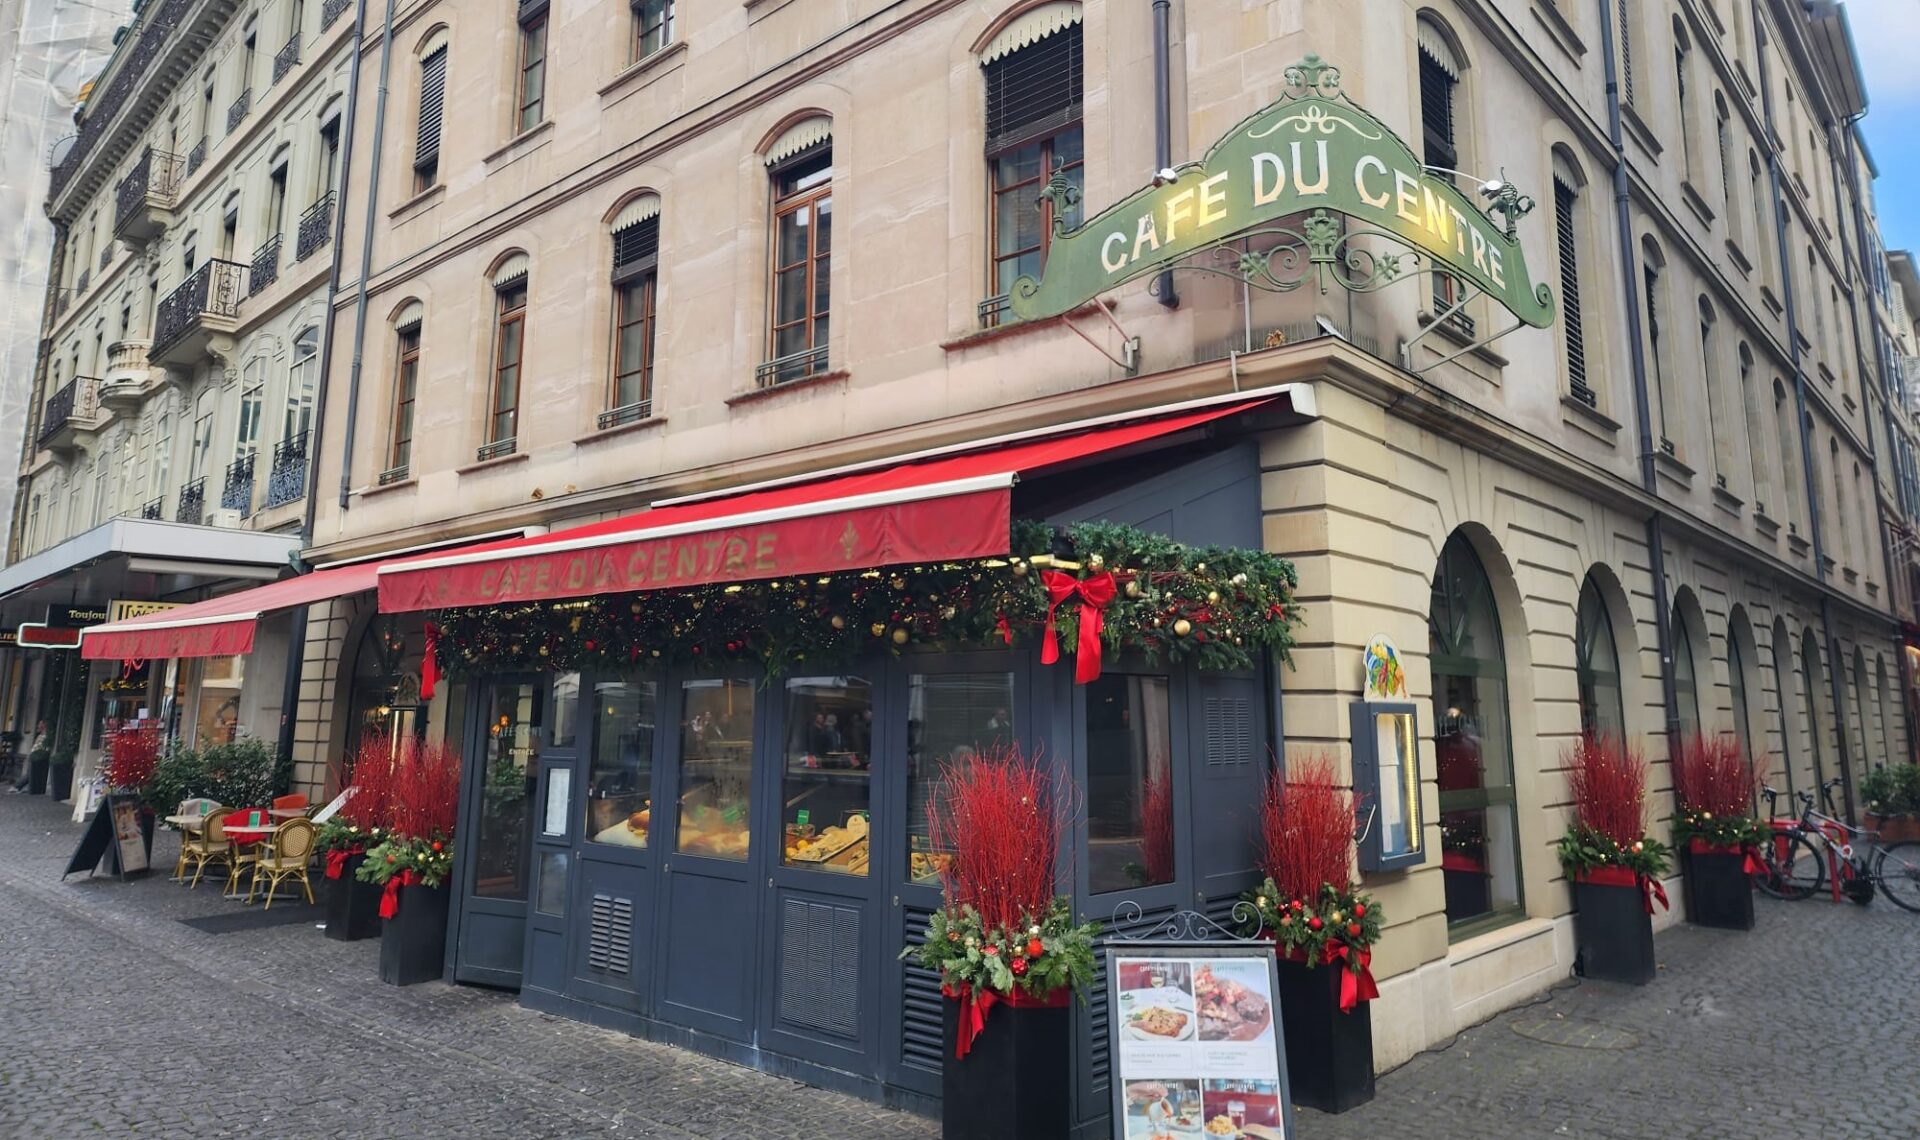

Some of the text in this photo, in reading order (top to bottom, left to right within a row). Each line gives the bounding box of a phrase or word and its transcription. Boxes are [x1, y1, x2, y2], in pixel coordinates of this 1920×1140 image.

[1101, 140, 1506, 291] CAFE DU CENTRE
[567, 552, 611, 590] DU
[627, 534, 777, 585] CENTRE
